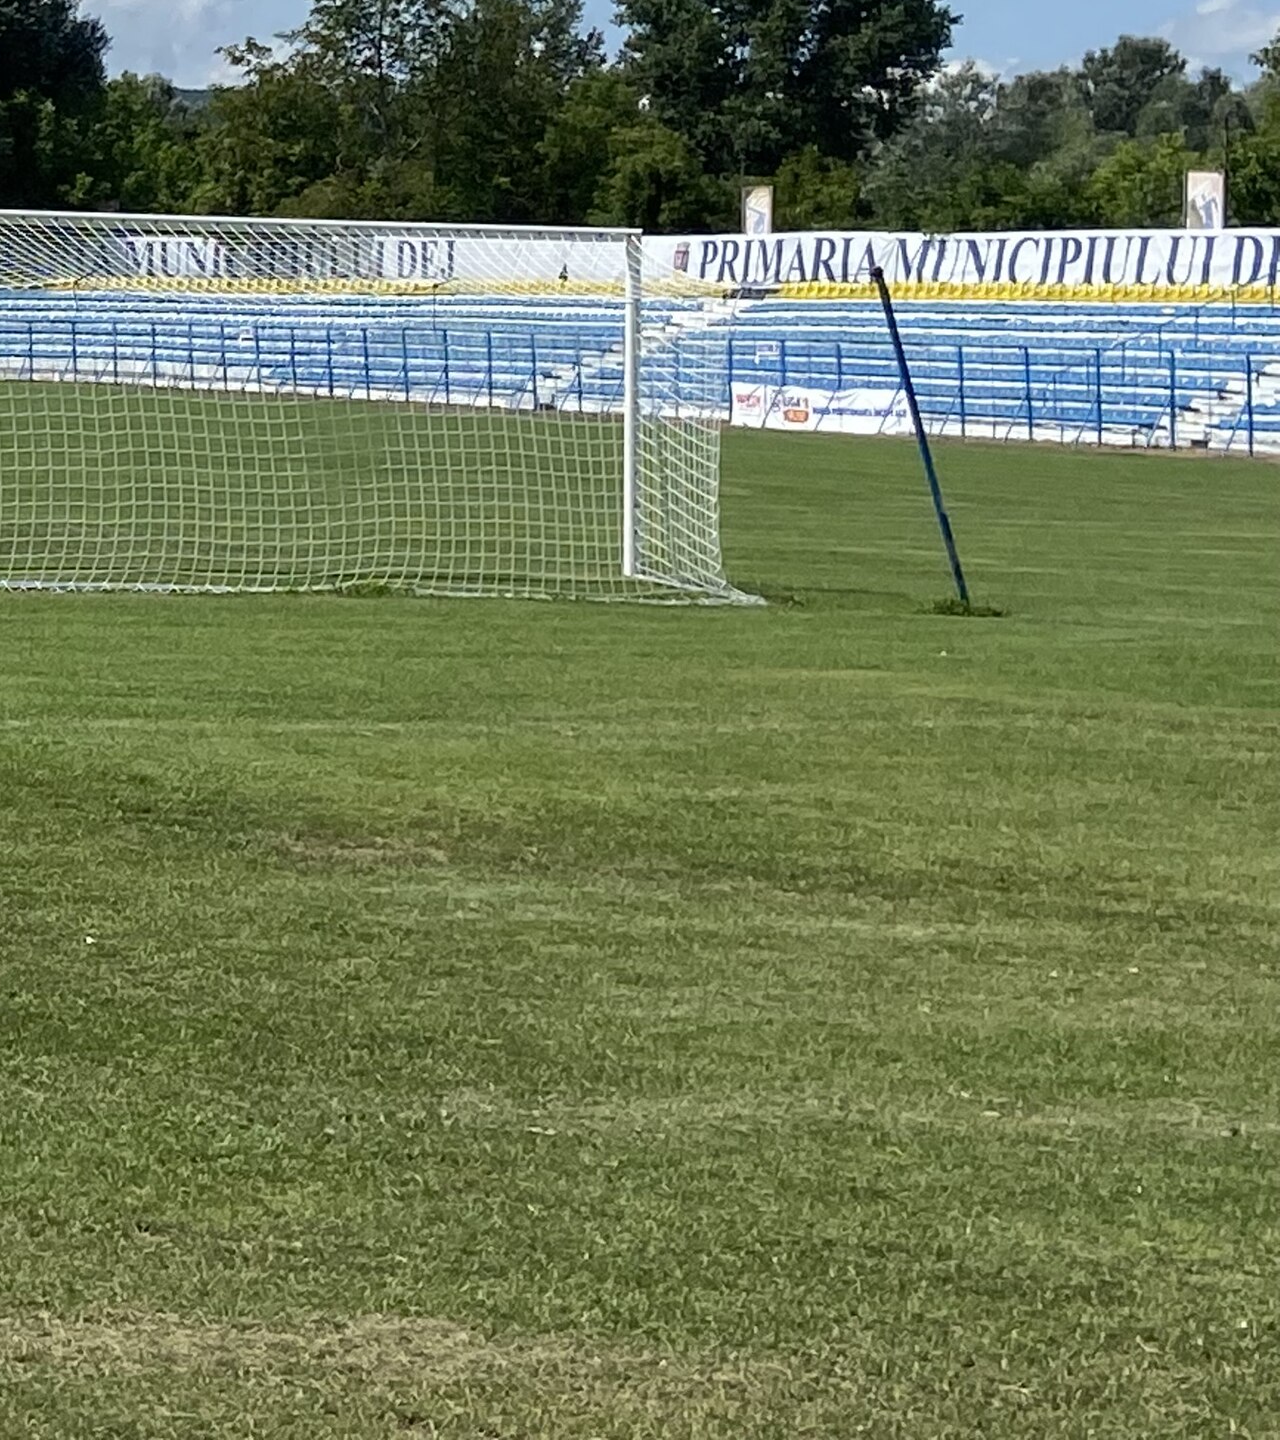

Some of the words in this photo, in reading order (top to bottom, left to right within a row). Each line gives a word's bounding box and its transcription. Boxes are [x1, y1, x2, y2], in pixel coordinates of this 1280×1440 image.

[397, 239, 457, 279] DEJ
[699, 236, 877, 284] PRIMARIA
[894, 235, 1220, 286] MUNICIPIULUI
